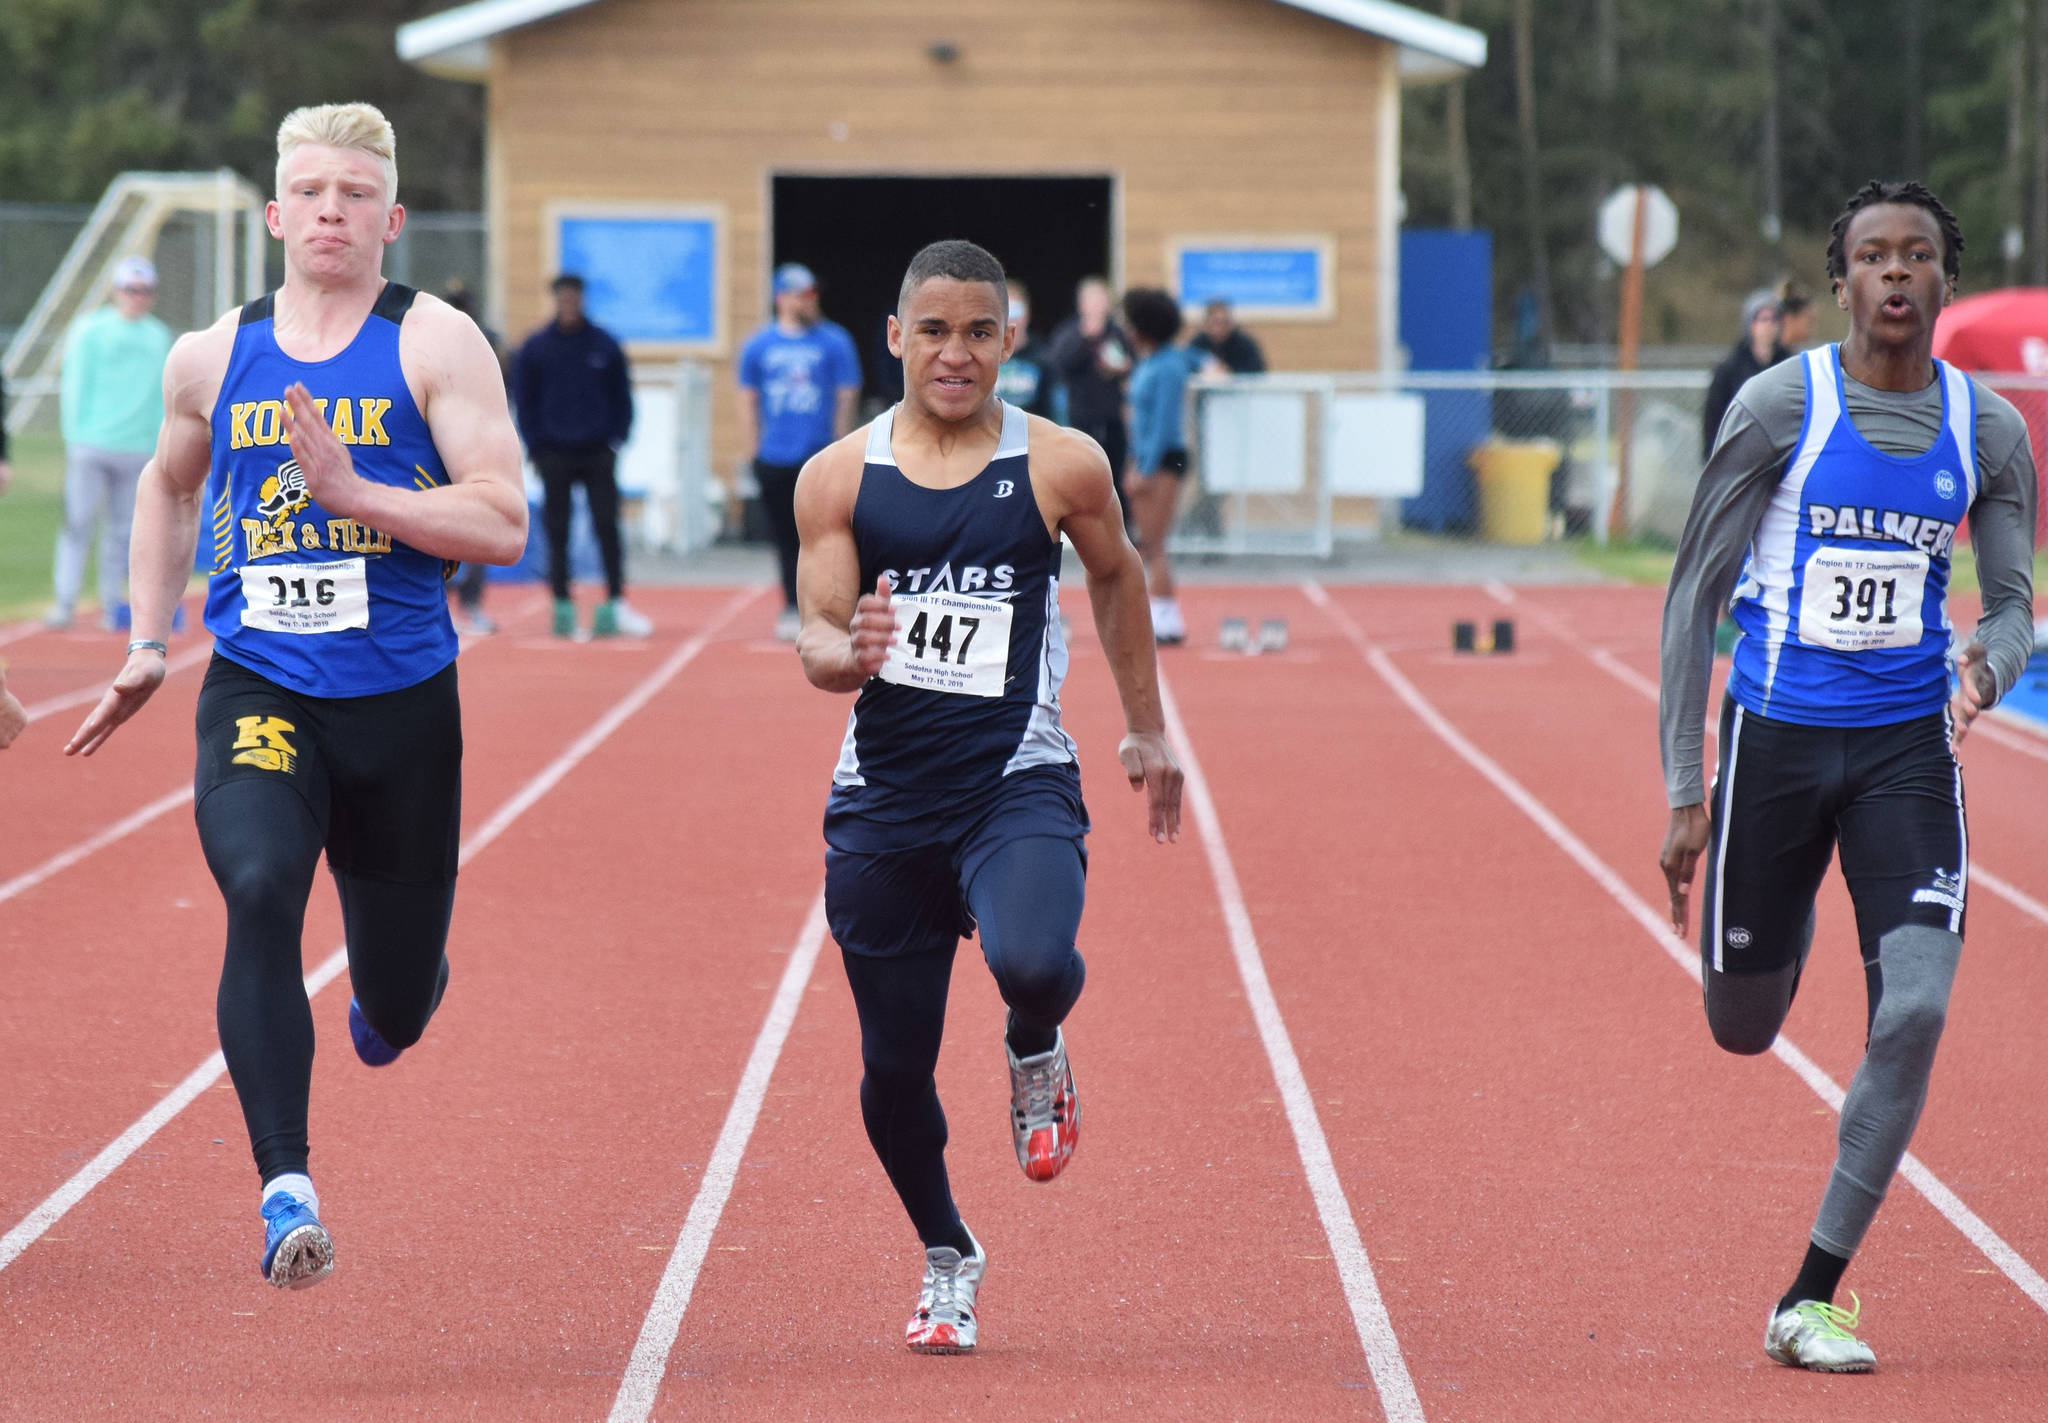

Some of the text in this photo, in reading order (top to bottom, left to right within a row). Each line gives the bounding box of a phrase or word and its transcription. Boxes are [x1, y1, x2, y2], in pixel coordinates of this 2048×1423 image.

[230, 397, 392, 450] KOAK
[301, 522, 323, 549] &
[1808, 503, 1957, 559] PALMER
[1815, 558, 1842, 568] Region
[1866, 562, 1920, 571] Championships
[881, 561, 1015, 593] STARS
[930, 596, 940, 605] TF
[941, 598, 1002, 612] Championships
[1830, 575, 1898, 625] 391
[313, 610, 337, 618] School
[906, 611, 980, 665] 447
[1836, 638, 1849, 646] May
[904, 662, 973, 679] Soldotna High School
[911, 674, 924, 683] May
[927, 677, 946, 686] 17-18,
[1730, 933, 1749, 943] KO
